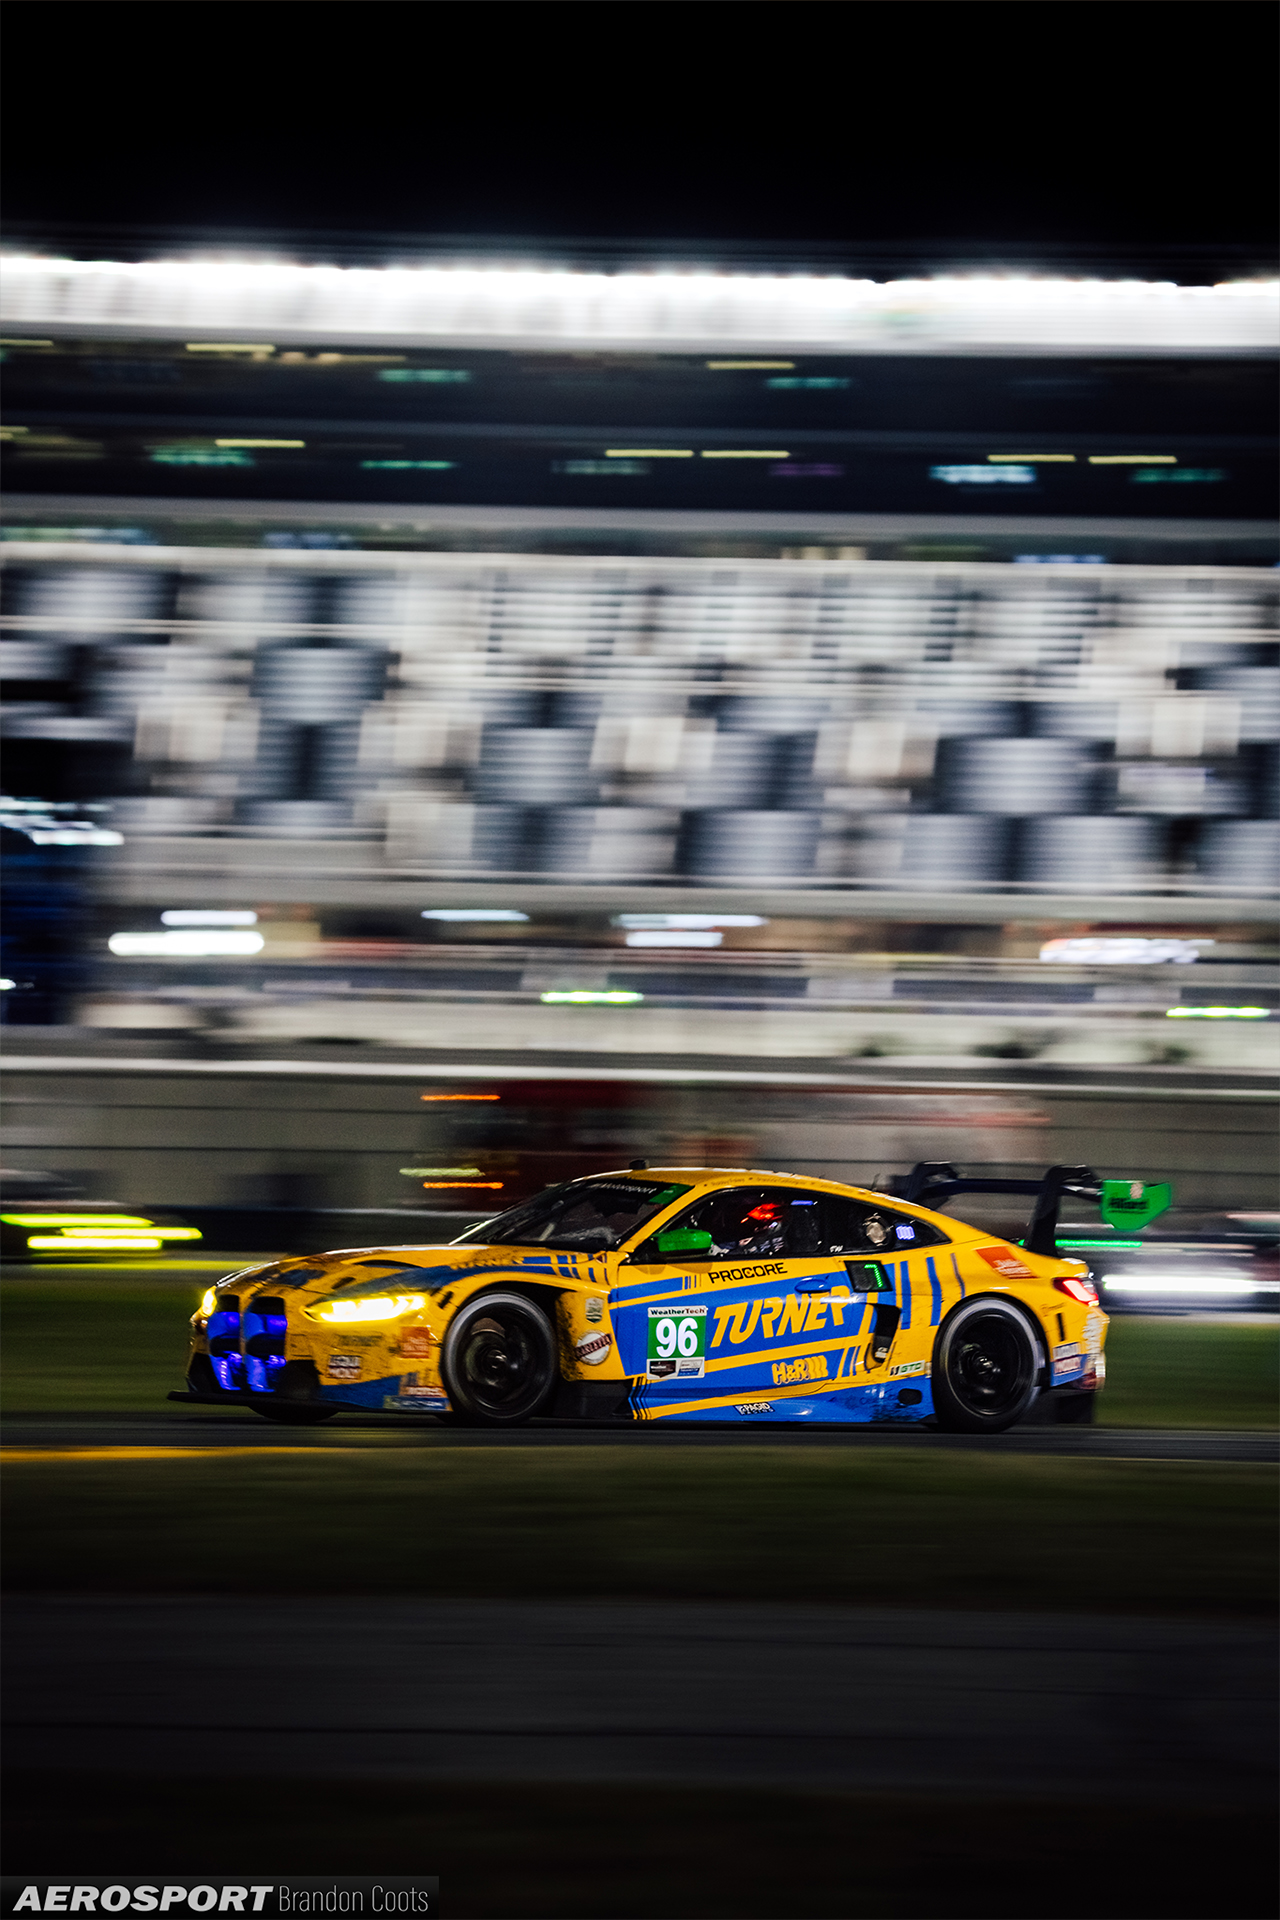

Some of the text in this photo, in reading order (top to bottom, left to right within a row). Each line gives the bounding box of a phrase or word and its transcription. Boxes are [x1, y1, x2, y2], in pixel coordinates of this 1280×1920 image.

[708, 1262, 788, 1284] PROCORE
[864, 1263, 884, 1288] 7
[650, 1307, 705, 1315] WeatherTech
[710, 1285, 851, 1348] TURNER
[656, 1317, 698, 1358] 96
